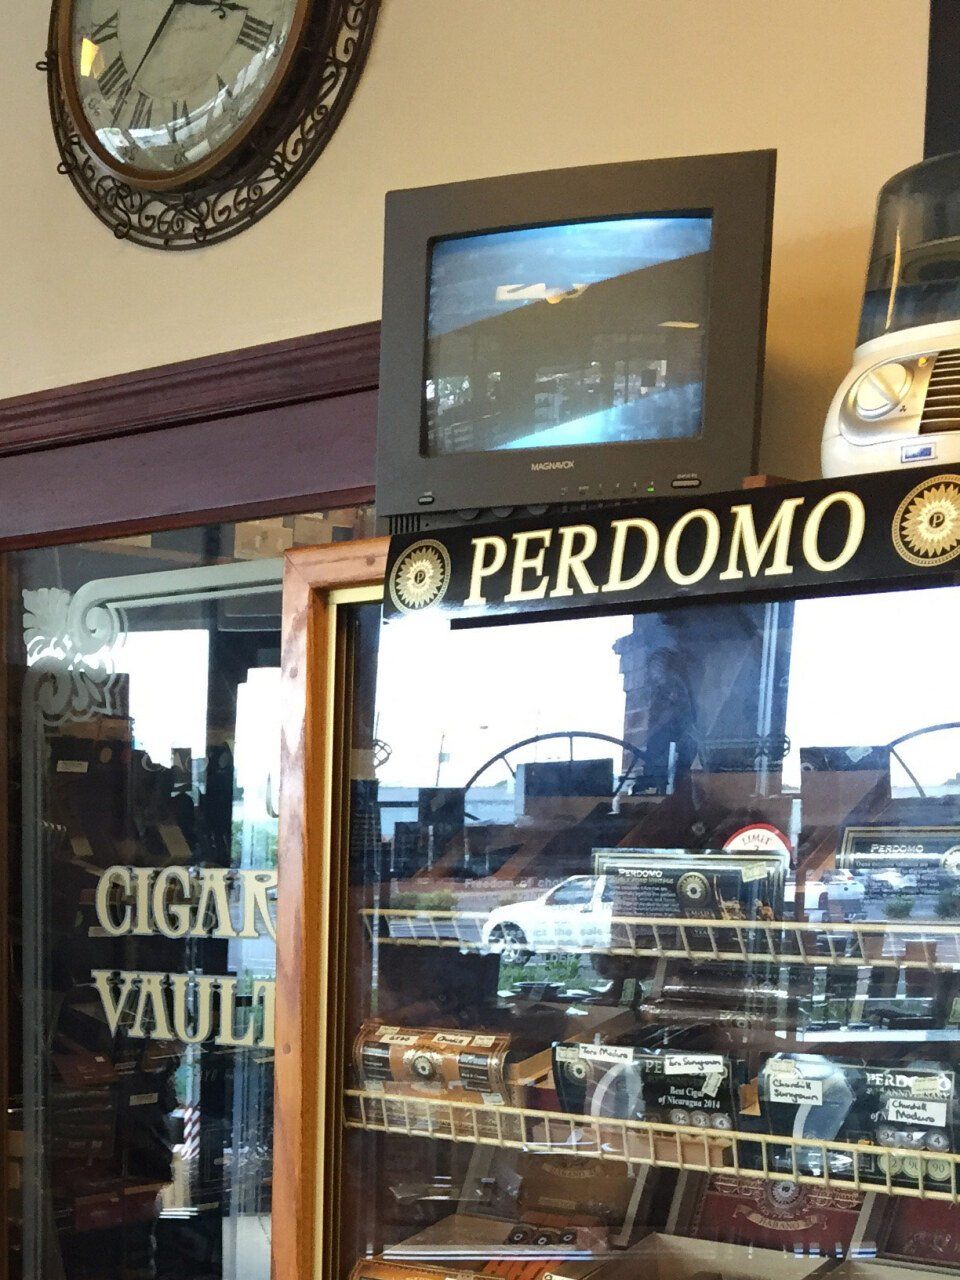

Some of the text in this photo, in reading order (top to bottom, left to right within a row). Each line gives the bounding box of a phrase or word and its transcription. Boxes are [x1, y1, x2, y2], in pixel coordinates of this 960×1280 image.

[531, 460, 575, 472] MAGNAVOX
[463, 490, 867, 607] PERDOMO
[742, 833, 772, 846] LIMIT
[870, 843, 924, 853] PERDOMO
[618, 868, 663, 878] PERDOMO
[94, 864, 278, 939] CIGAR
[90, 968, 277, 1048] VAULT
[669, 1086, 684, 1096] Best
[658, 1096, 721, 1109] of Nicaragua 2014
